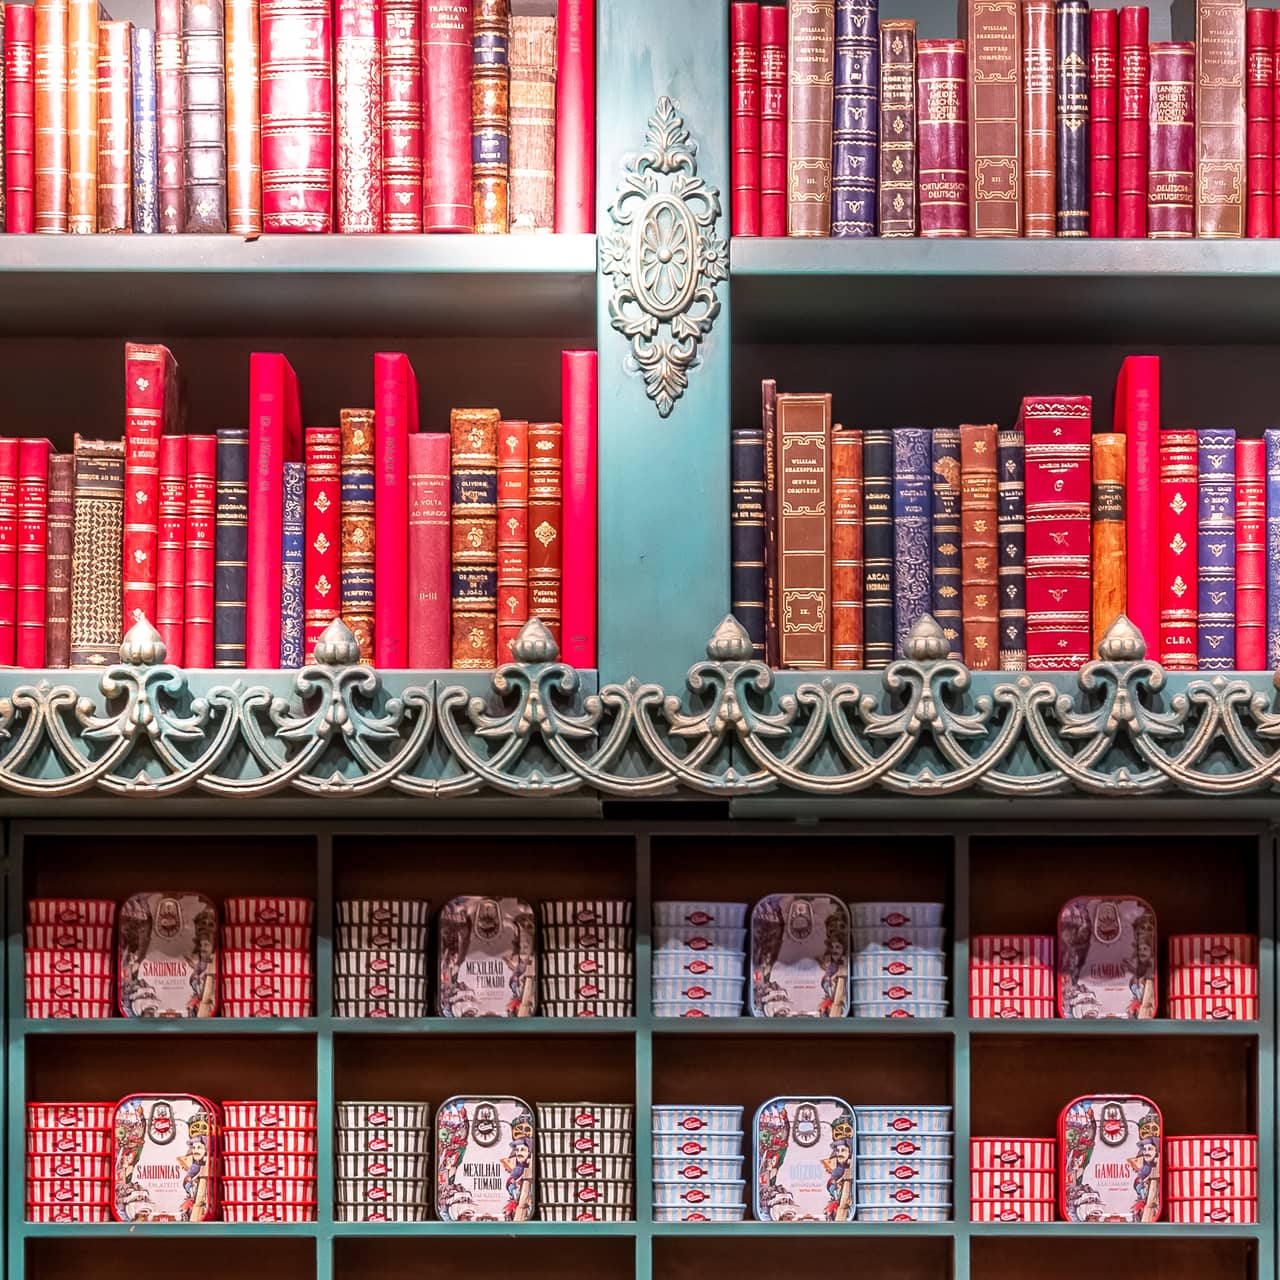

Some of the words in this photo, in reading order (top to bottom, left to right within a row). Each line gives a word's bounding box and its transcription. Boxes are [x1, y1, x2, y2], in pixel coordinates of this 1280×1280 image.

[1166, 635, 1192, 645] CLEA
[143, 961, 187, 976] SARDINHAS
[466, 960, 503, 976] MEXILHÃO
[1090, 960, 1125, 978] GAMBAS
[476, 976, 505, 989] FUMADO
[137, 1164, 180, 1179] SARDINHAS
[463, 1163, 500, 1177] MEXILHÃO
[1095, 1163, 1129, 1180] GAMBAS
[474, 1178, 502, 1190] FUMADO
